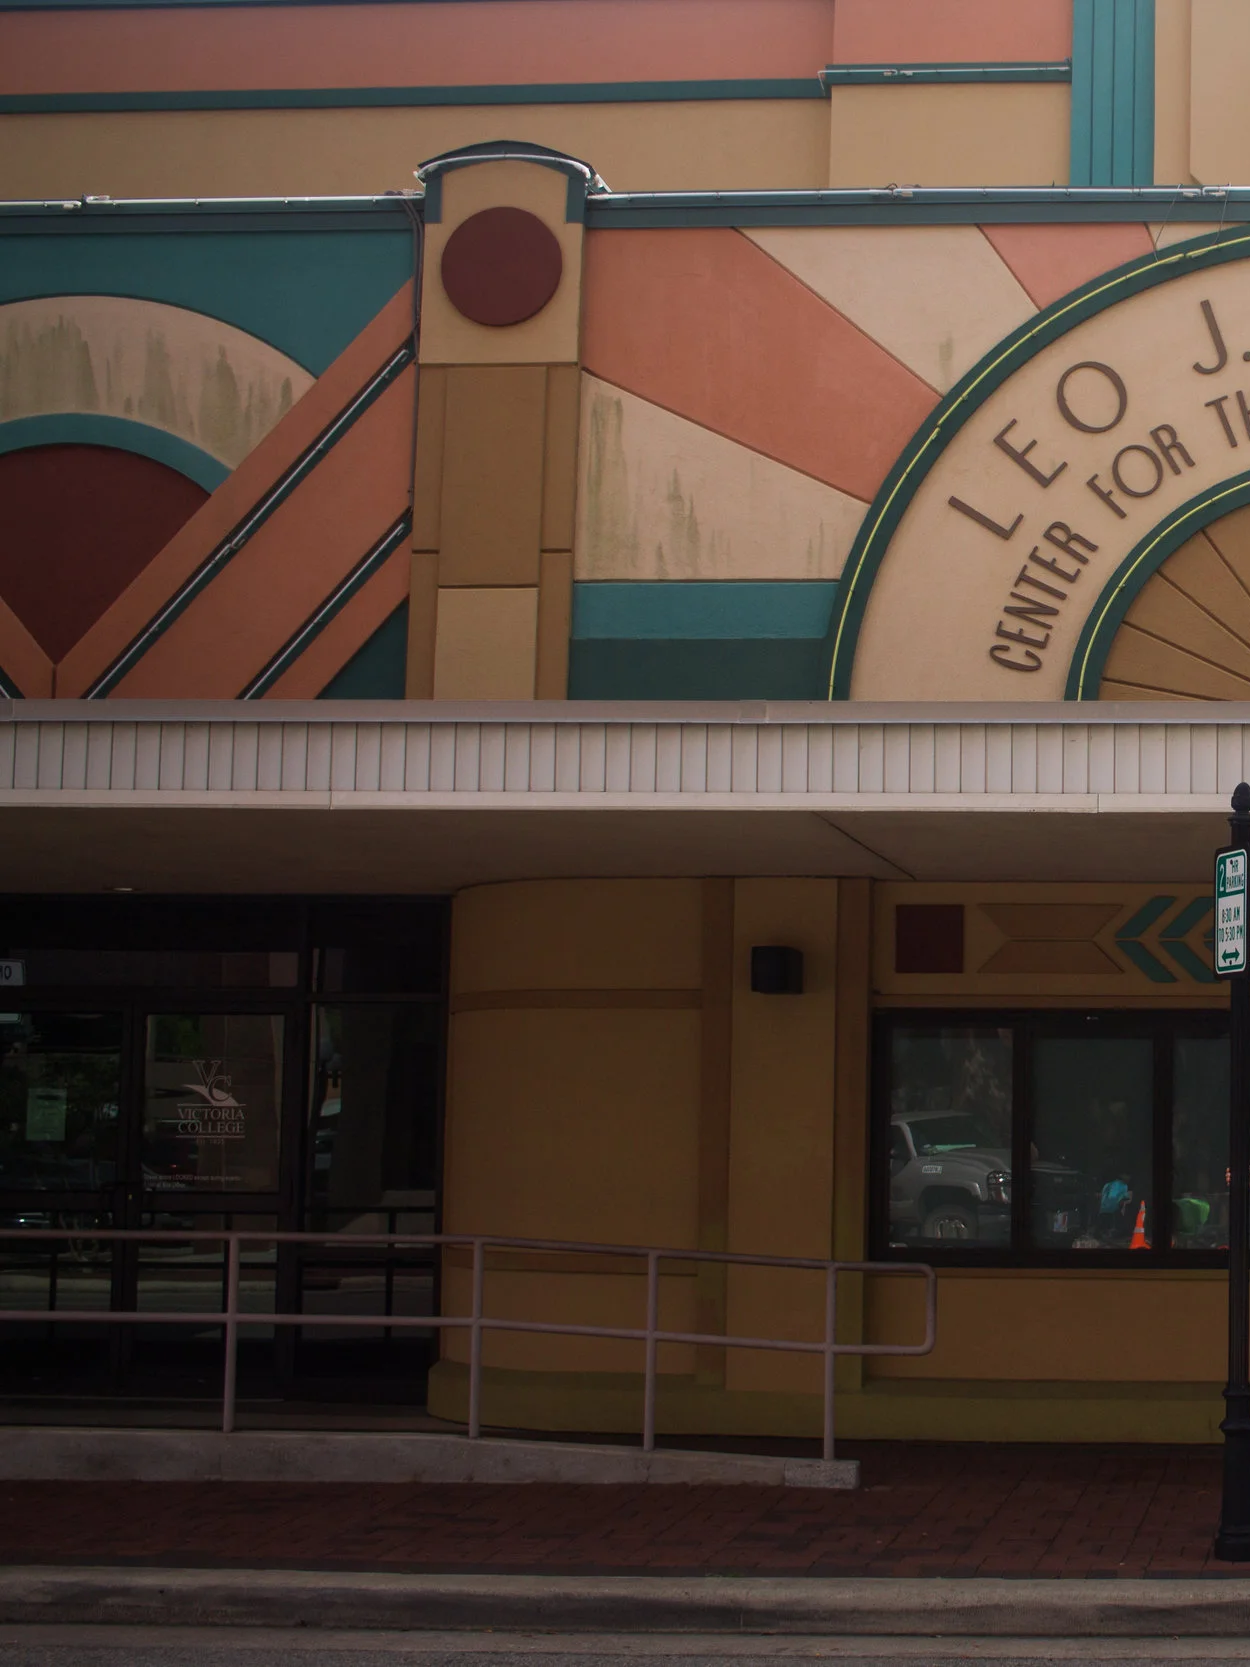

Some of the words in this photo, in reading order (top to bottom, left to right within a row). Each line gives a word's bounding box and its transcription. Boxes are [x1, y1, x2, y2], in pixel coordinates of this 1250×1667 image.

[947, 360, 1129, 541] LEO
[988, 519, 1100, 675] CENTER
[1085, 421, 1197, 519] FOR
[1219, 864, 1225, 892] 2
[1226, 874, 1244, 889] PARKING
[1233, 906, 1240, 922] AM
[1236, 924, 1244, 940] PM
[177, 1108, 245, 1120] VICTORIA
[177, 1121, 246, 1134] COLLEGE
